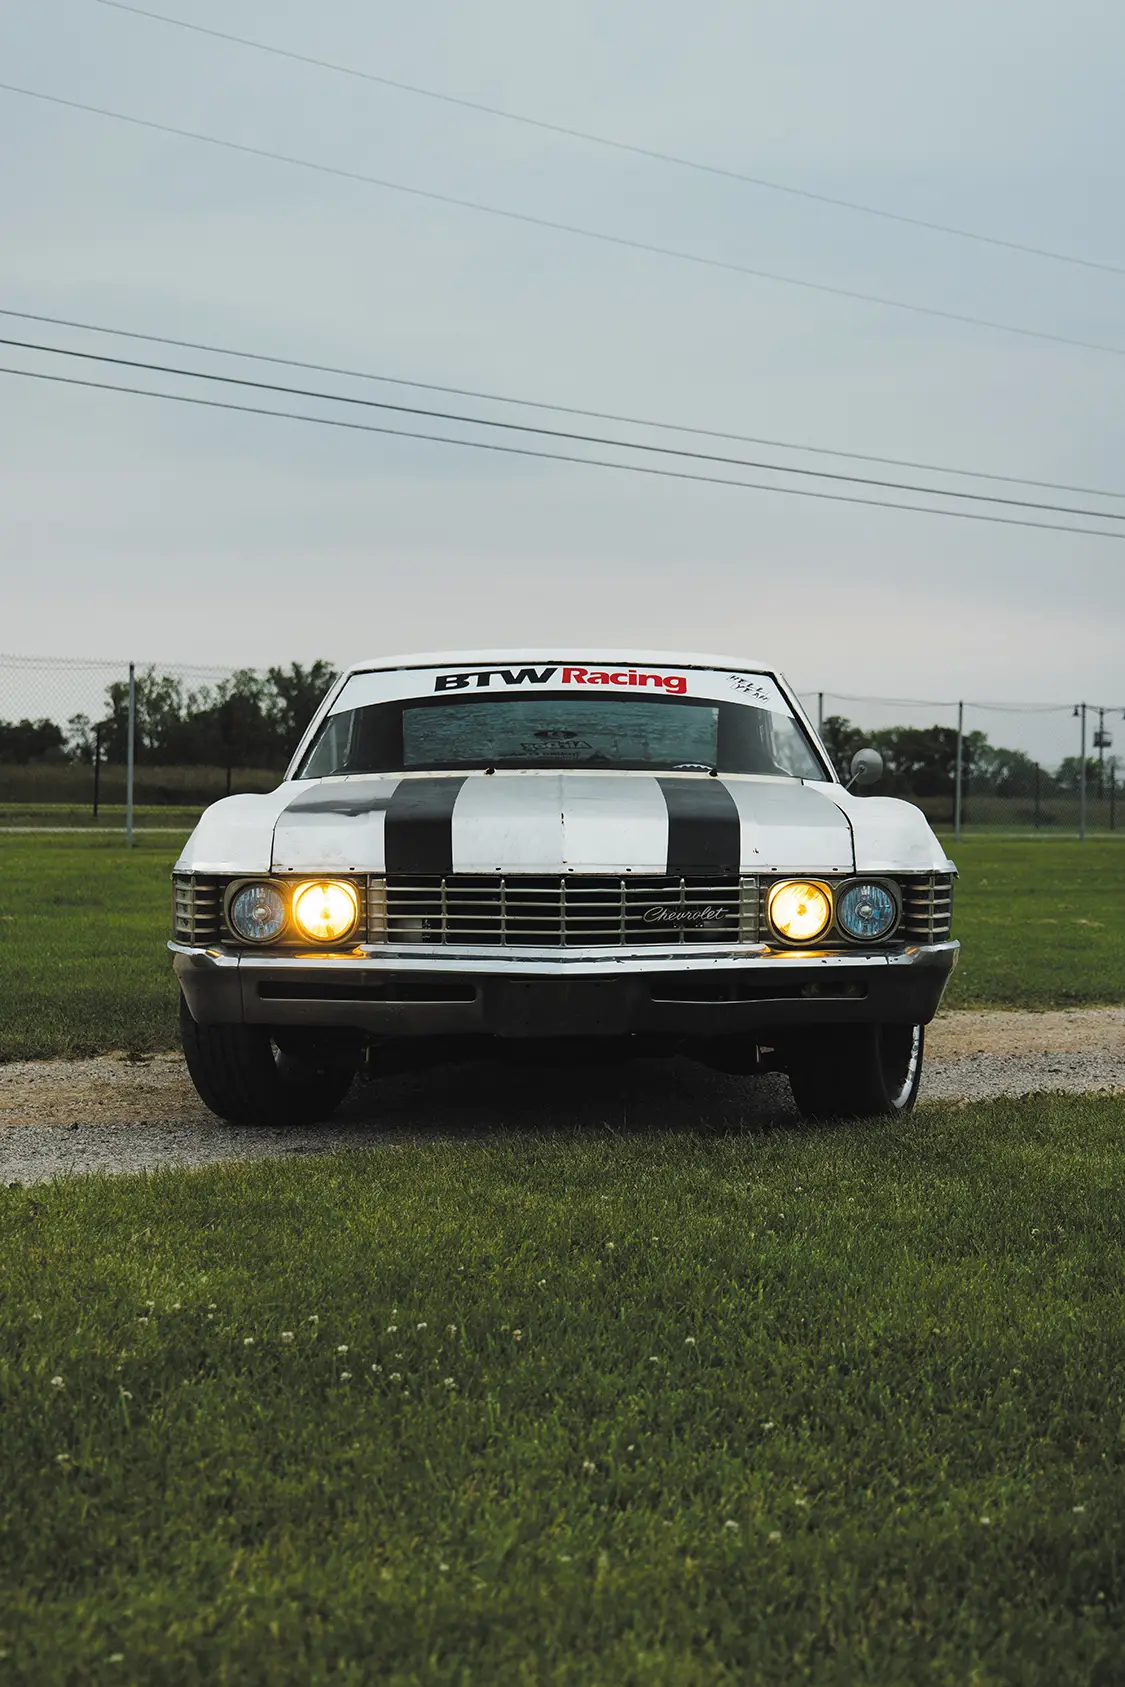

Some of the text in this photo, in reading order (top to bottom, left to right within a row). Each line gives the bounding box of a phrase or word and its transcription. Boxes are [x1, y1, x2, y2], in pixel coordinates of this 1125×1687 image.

[434, 667, 688, 694] BTW Racing
[729, 675, 765, 693] HELL
[735, 684, 768, 702] YEAH
[643, 906, 729, 922] Chevrolet
